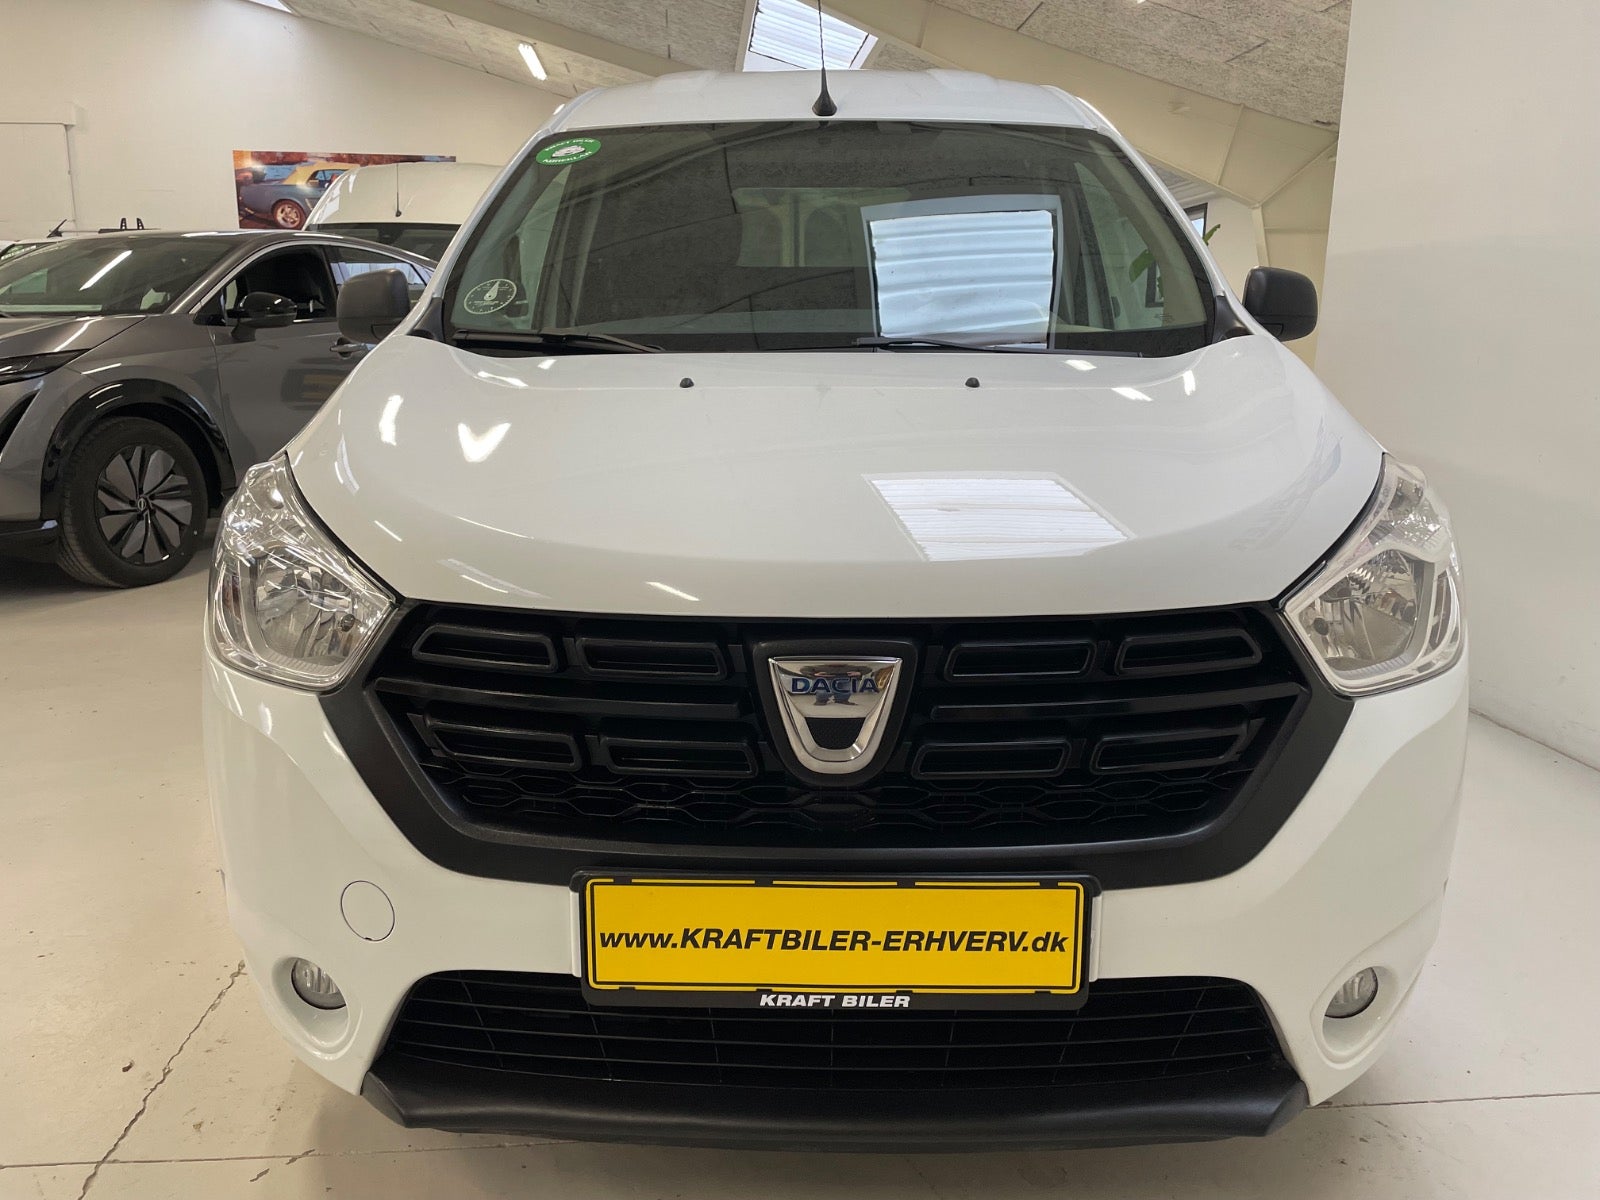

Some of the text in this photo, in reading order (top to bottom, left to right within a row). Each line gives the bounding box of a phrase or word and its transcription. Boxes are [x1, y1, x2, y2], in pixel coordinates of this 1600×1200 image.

[791, 677, 879, 693] DACIA
[599, 927, 1069, 953] www.KRAFTBILER-ERHVERV.dk
[759, 994, 911, 1008] KRAFT BILER
